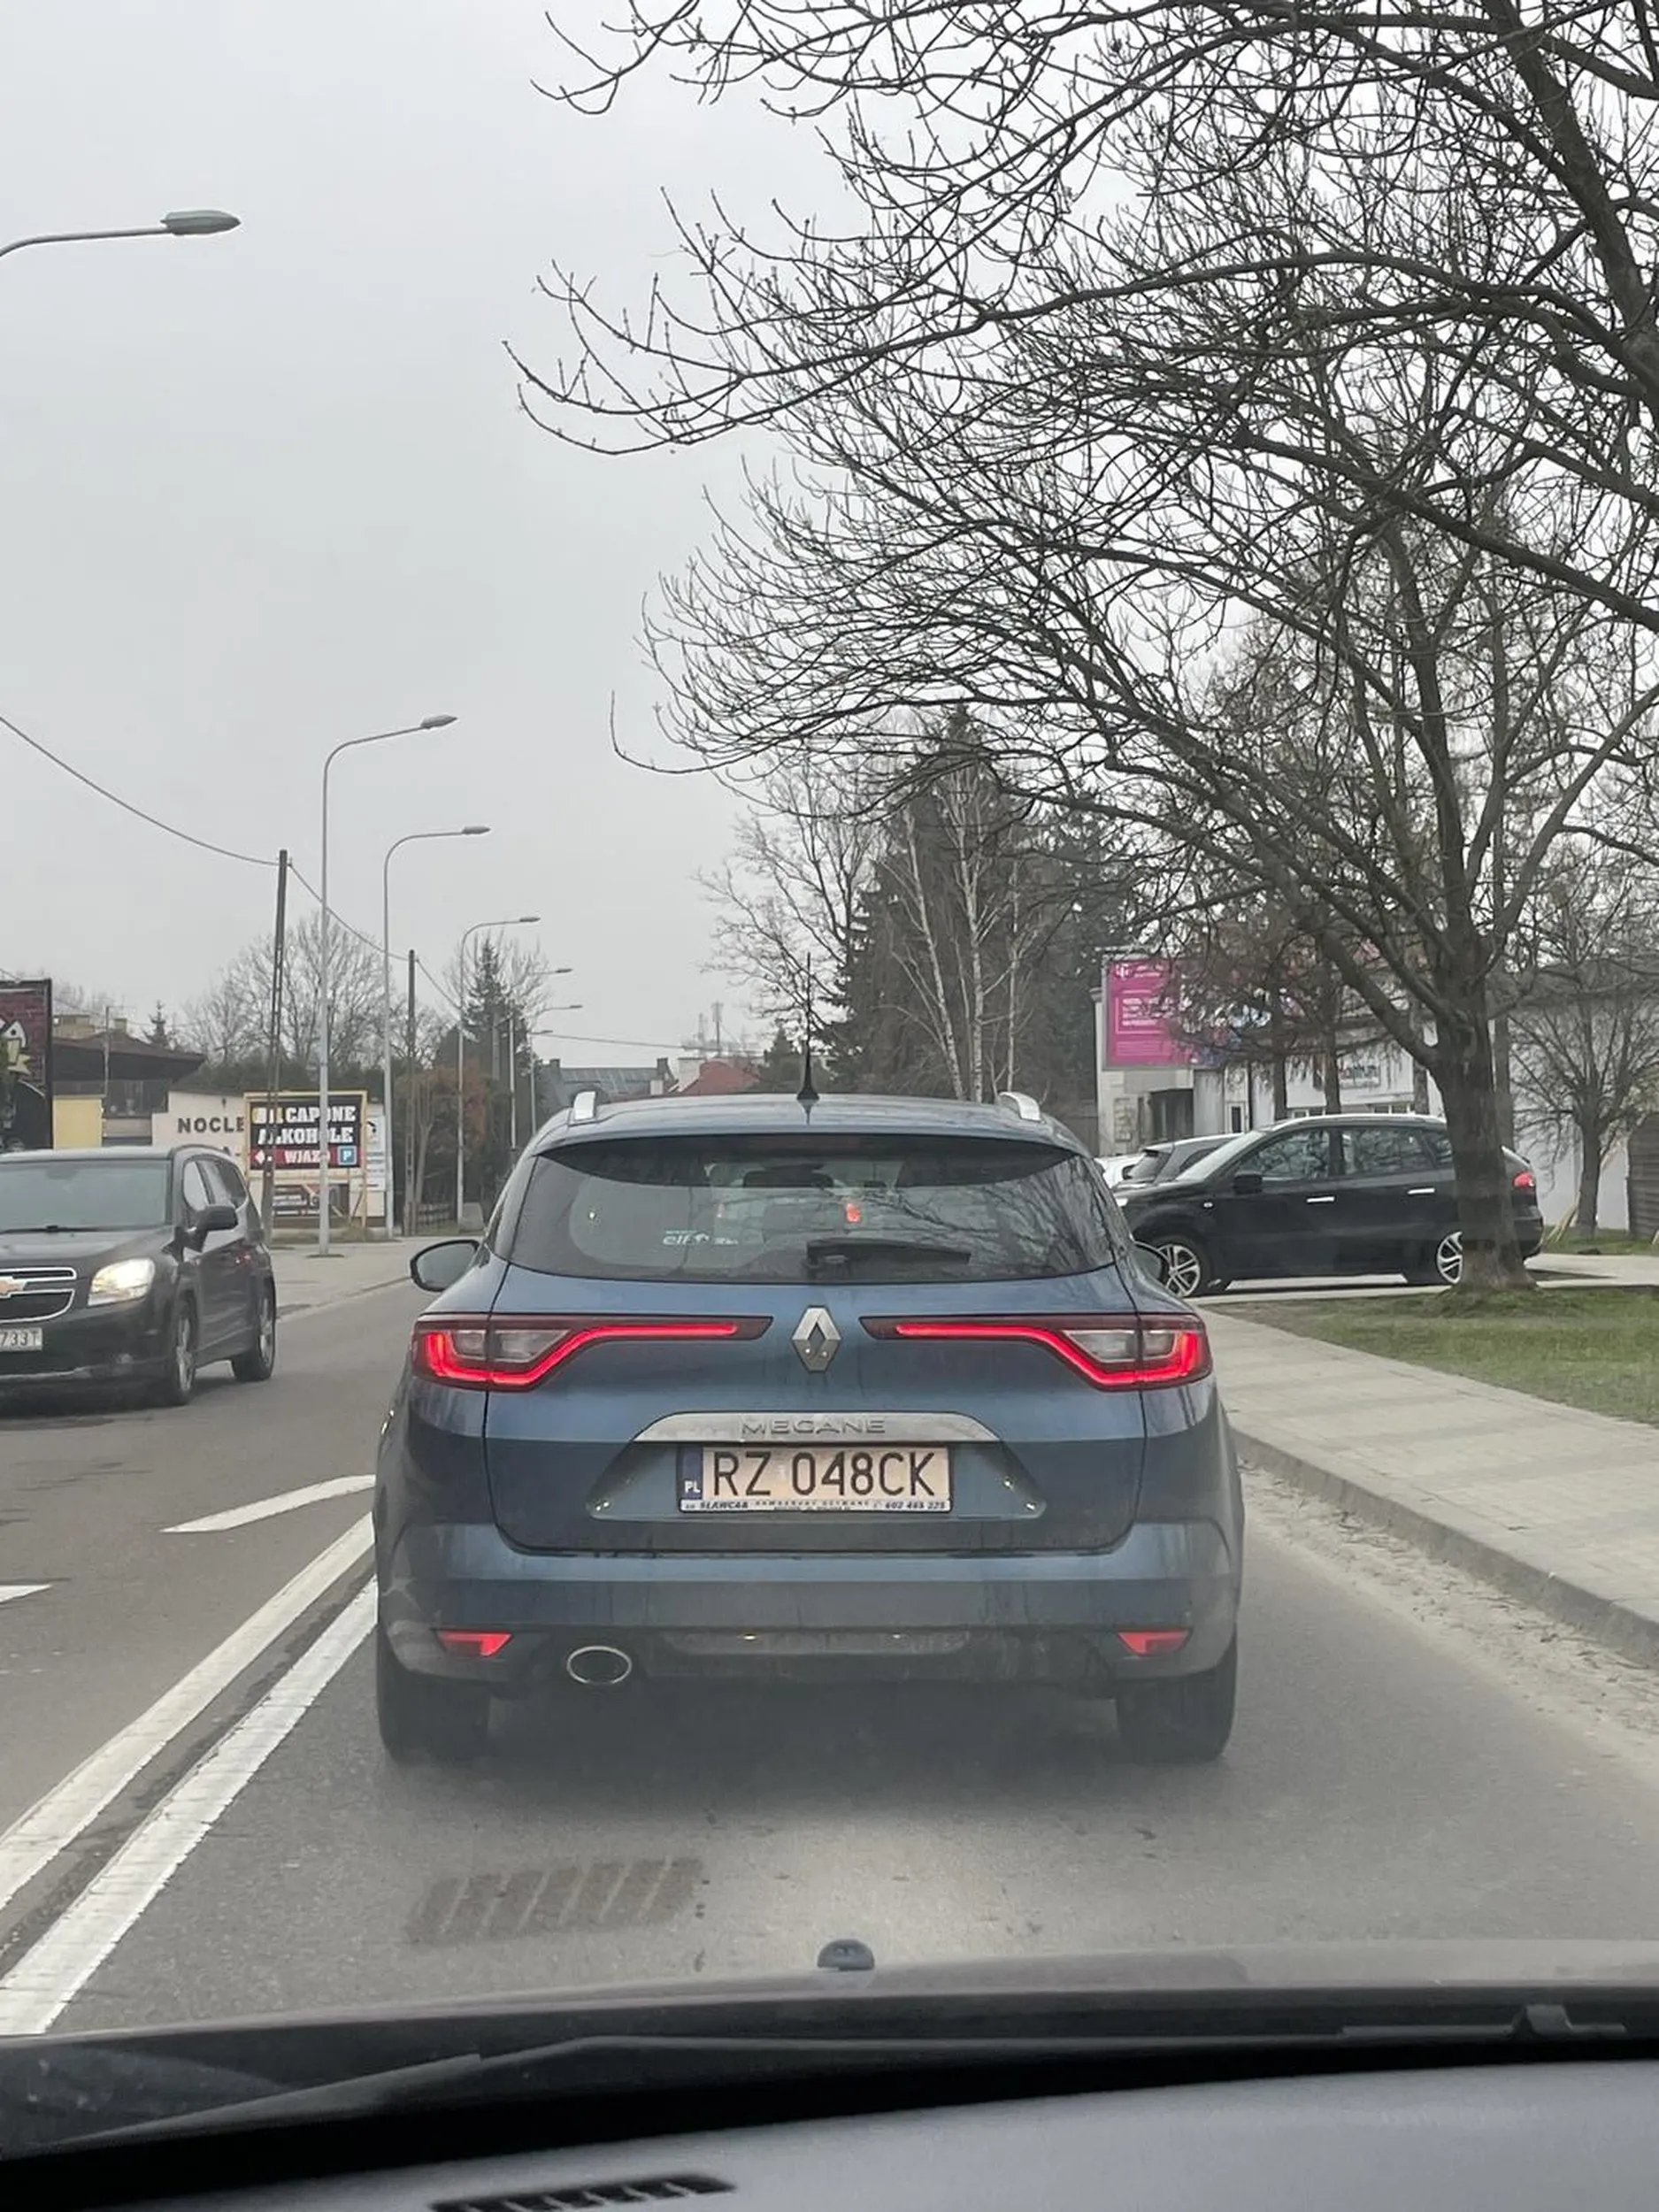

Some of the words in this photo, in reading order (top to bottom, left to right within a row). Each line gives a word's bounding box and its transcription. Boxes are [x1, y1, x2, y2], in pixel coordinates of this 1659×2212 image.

[741, 1419, 886, 1435] MEGANE
[713, 1451, 771, 1496] RZ
[792, 1451, 935, 1496] 048CK
[684, 1480, 702, 1494] PL
